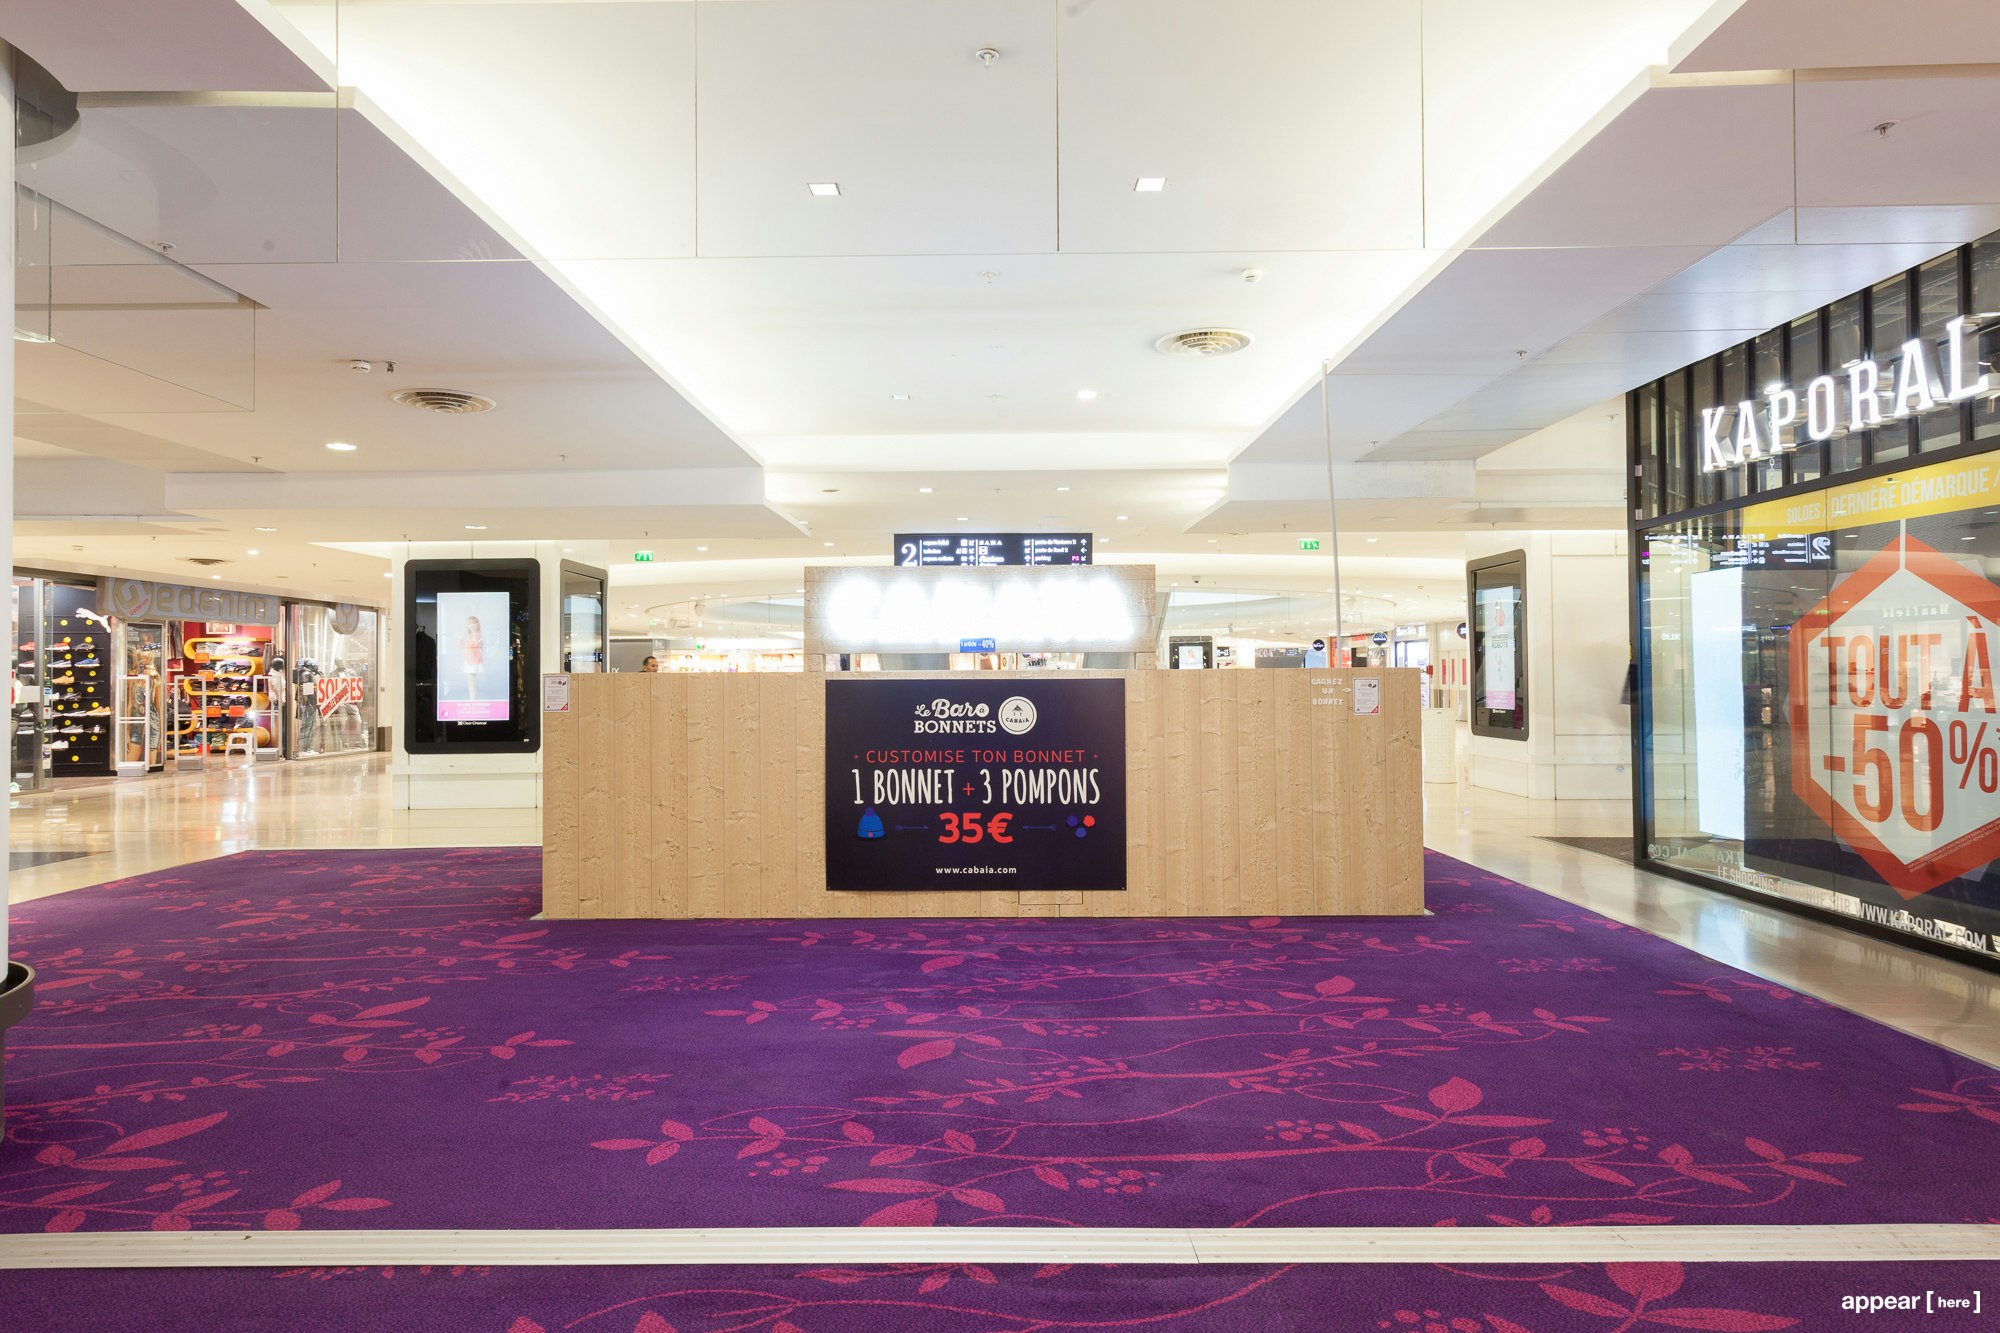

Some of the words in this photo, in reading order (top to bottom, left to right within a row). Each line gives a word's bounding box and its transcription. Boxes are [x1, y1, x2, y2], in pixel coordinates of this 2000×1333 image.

[1702, 314, 1990, 472] KAPORAL
[1786, 502, 1820, 524] SOLDES
[1831, 485, 1897, 518] DERNIÈRE
[1900, 466, 1990, 506] DÉMARQUE
[900, 544, 918, 565] 2
[1820, 634, 1942, 710] TOUT
[1958, 615, 1996, 714] À
[915, 704, 931, 717] Le
[932, 698, 976, 719] Bar
[914, 720, 997, 734] BONNETS
[866, 750, 966, 763] CUSTOMISE
[972, 750, 1007, 763] TON
[1014, 750, 1086, 763] BONNET
[852, 768, 864, 805] 1
[874, 768, 955, 805] BONNET
[962, 782, 975, 796] +
[980, 769, 993, 804] 3
[1002, 768, 1101, 805] POMPONS
[938, 812, 1014, 844] 35€
[936, 865, 1017, 874] www.cabaia.com
[1730, 868, 1774, 893] SHOPPING
[1856, 900, 1987, 952] WWW.KAPORAL.COM
